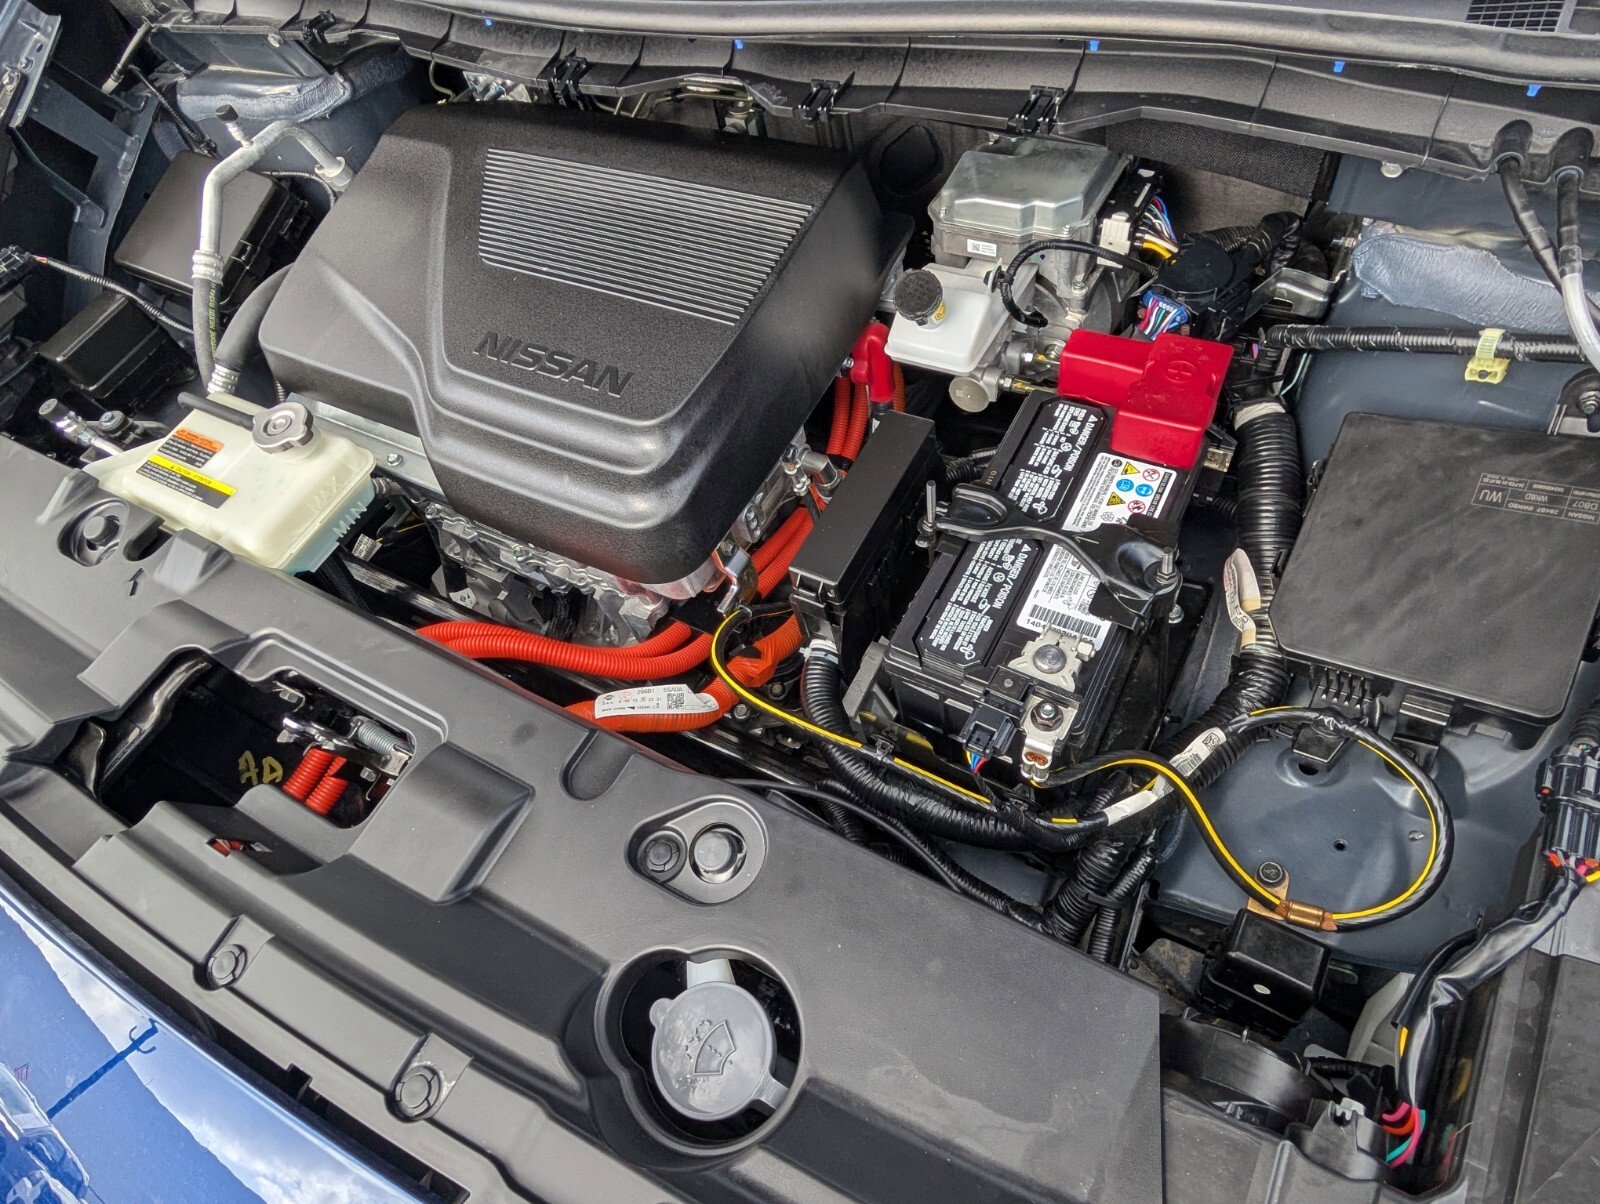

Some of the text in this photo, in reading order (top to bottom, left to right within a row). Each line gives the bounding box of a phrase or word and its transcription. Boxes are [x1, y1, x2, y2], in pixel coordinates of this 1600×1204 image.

[472, 331, 635, 398] NISSAN
[1076, 421, 1095, 445] DANGER
[1063, 449, 1081, 471] POISON
[1478, 488, 1502, 502] WU
[332, 501, 368, 538] MIN
[1007, 552, 1027, 579] DANGER
[991, 583, 1011, 608] POISON
